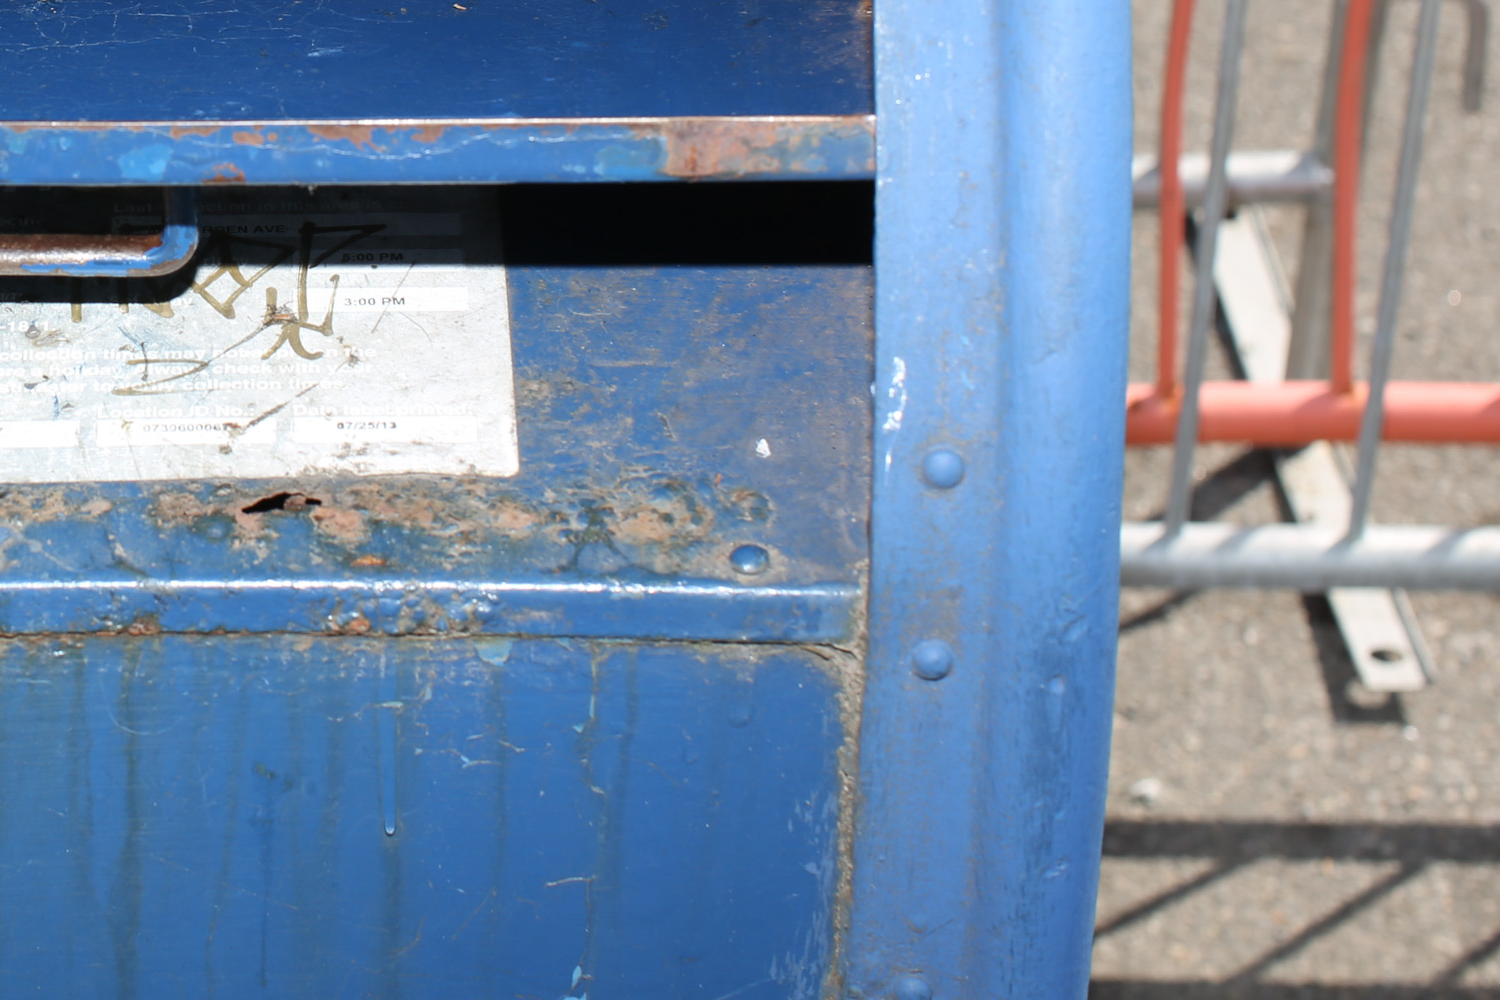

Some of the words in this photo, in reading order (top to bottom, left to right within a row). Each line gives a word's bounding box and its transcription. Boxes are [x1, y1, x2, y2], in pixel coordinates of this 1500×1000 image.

[252, 224, 286, 234] AVE
[342, 252, 374, 262] 5:00
[379, 252, 404, 262] PM
[344, 296, 377, 307] 3:00
[381, 295, 406, 306] PM
[212, 363, 273, 376] check
[278, 362, 321, 376] with
[182, 377, 283, 391] collection
[97, 405, 187, 418] Location
[189, 405, 213, 417] ID
